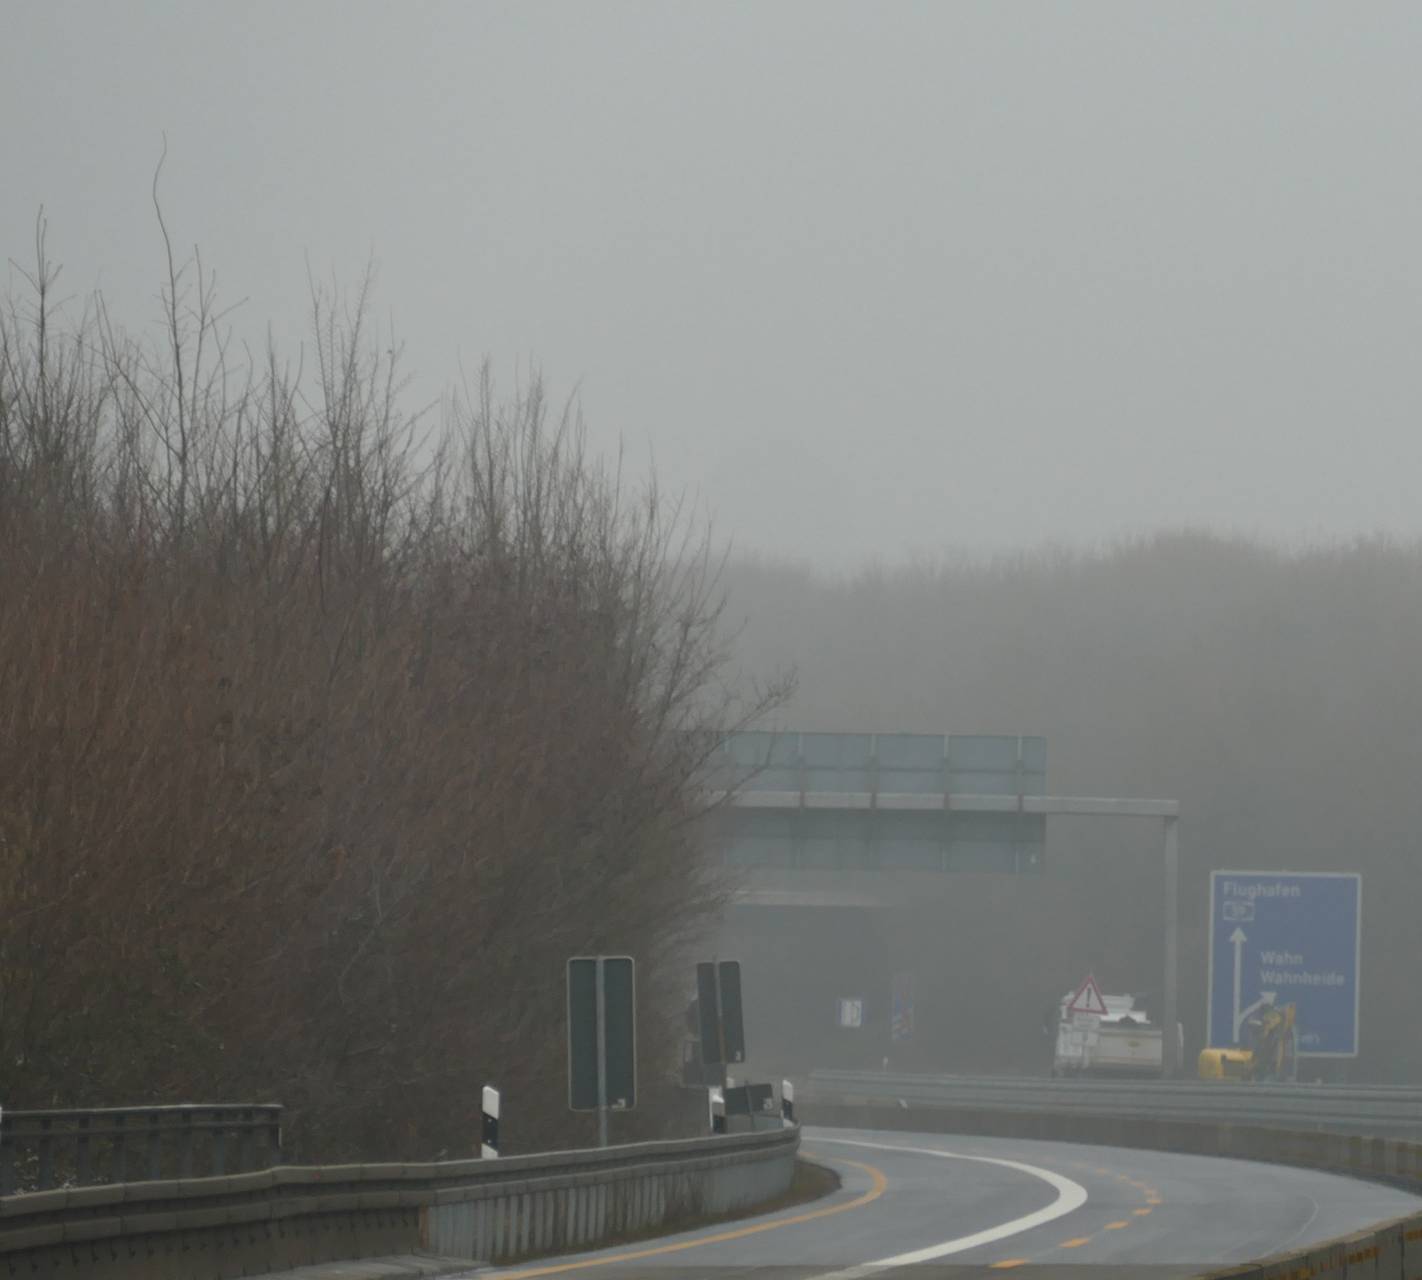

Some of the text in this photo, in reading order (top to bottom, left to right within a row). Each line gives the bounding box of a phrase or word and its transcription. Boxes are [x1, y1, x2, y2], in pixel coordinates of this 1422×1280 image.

[1223, 881, 1300, 899] Flughafen
[1260, 951, 1303, 965] Wahn
[1259, 970, 1345, 986] Wahnheide
